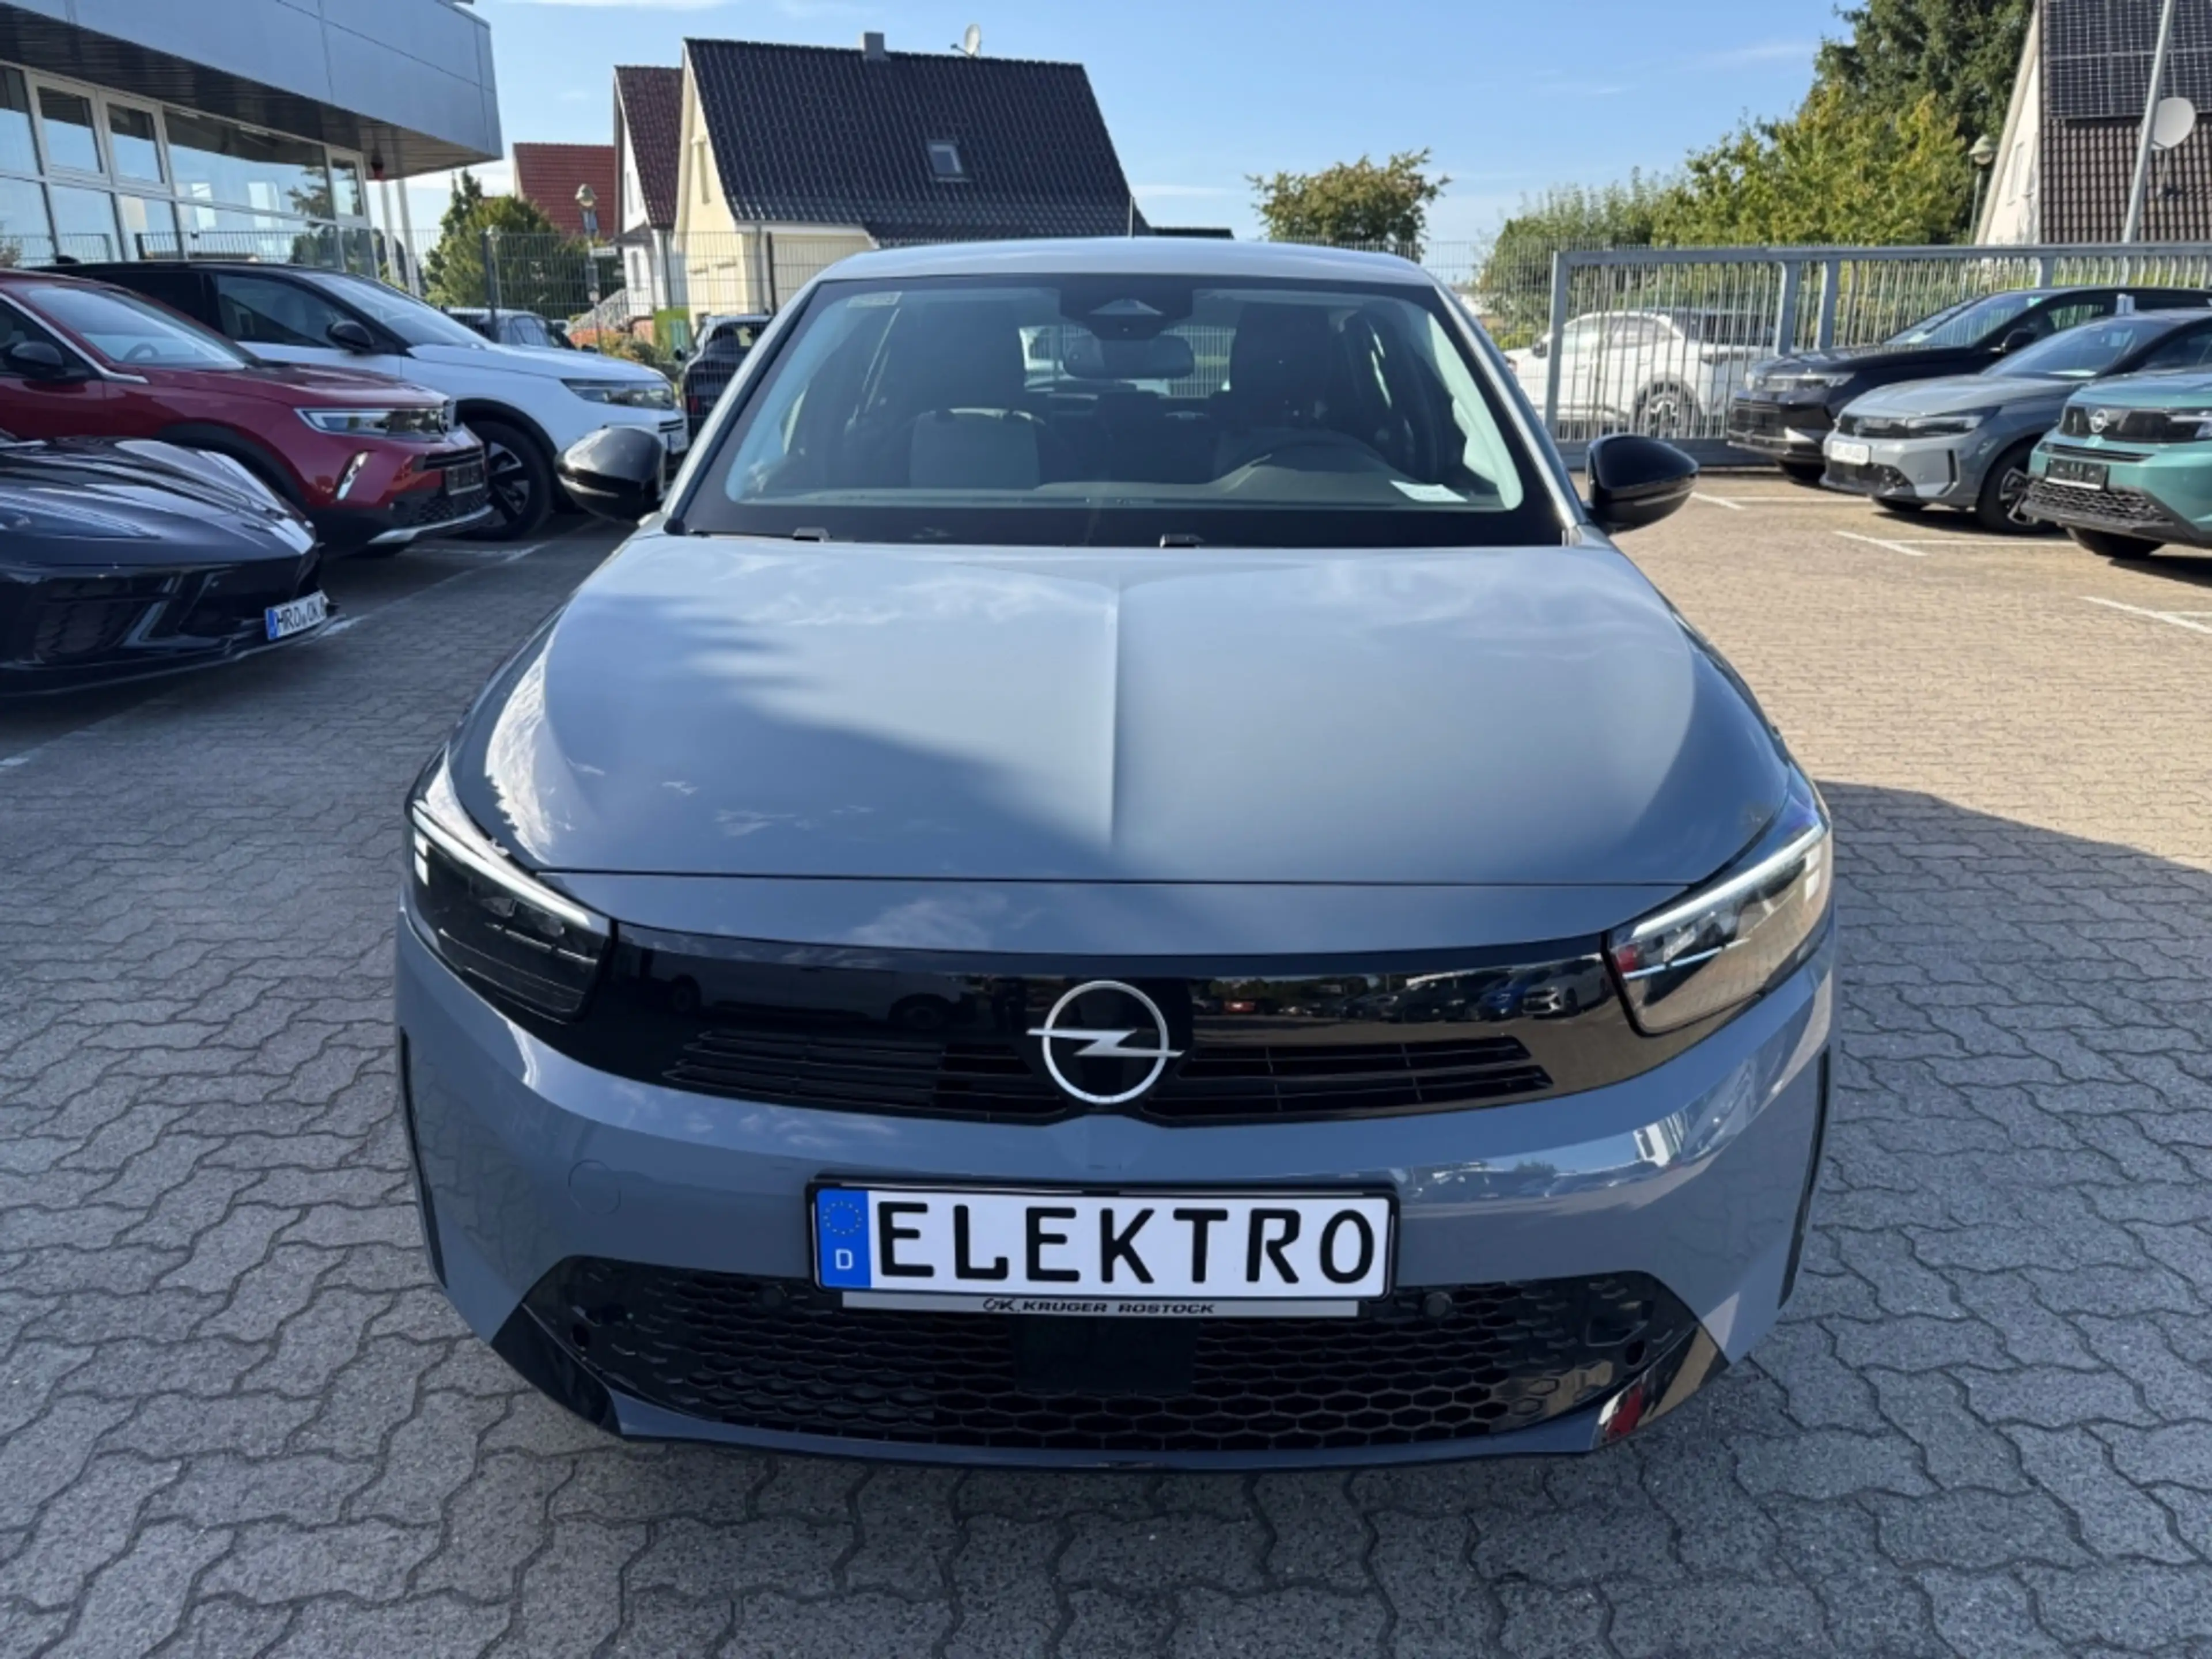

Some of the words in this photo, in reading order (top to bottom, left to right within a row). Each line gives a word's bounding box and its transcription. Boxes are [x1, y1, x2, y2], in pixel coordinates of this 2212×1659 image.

[835, 1249, 853, 1270] D
[877, 1200, 1375, 1284] ELEKTRO
[1118, 1302, 1215, 1315] ROSTOCK
